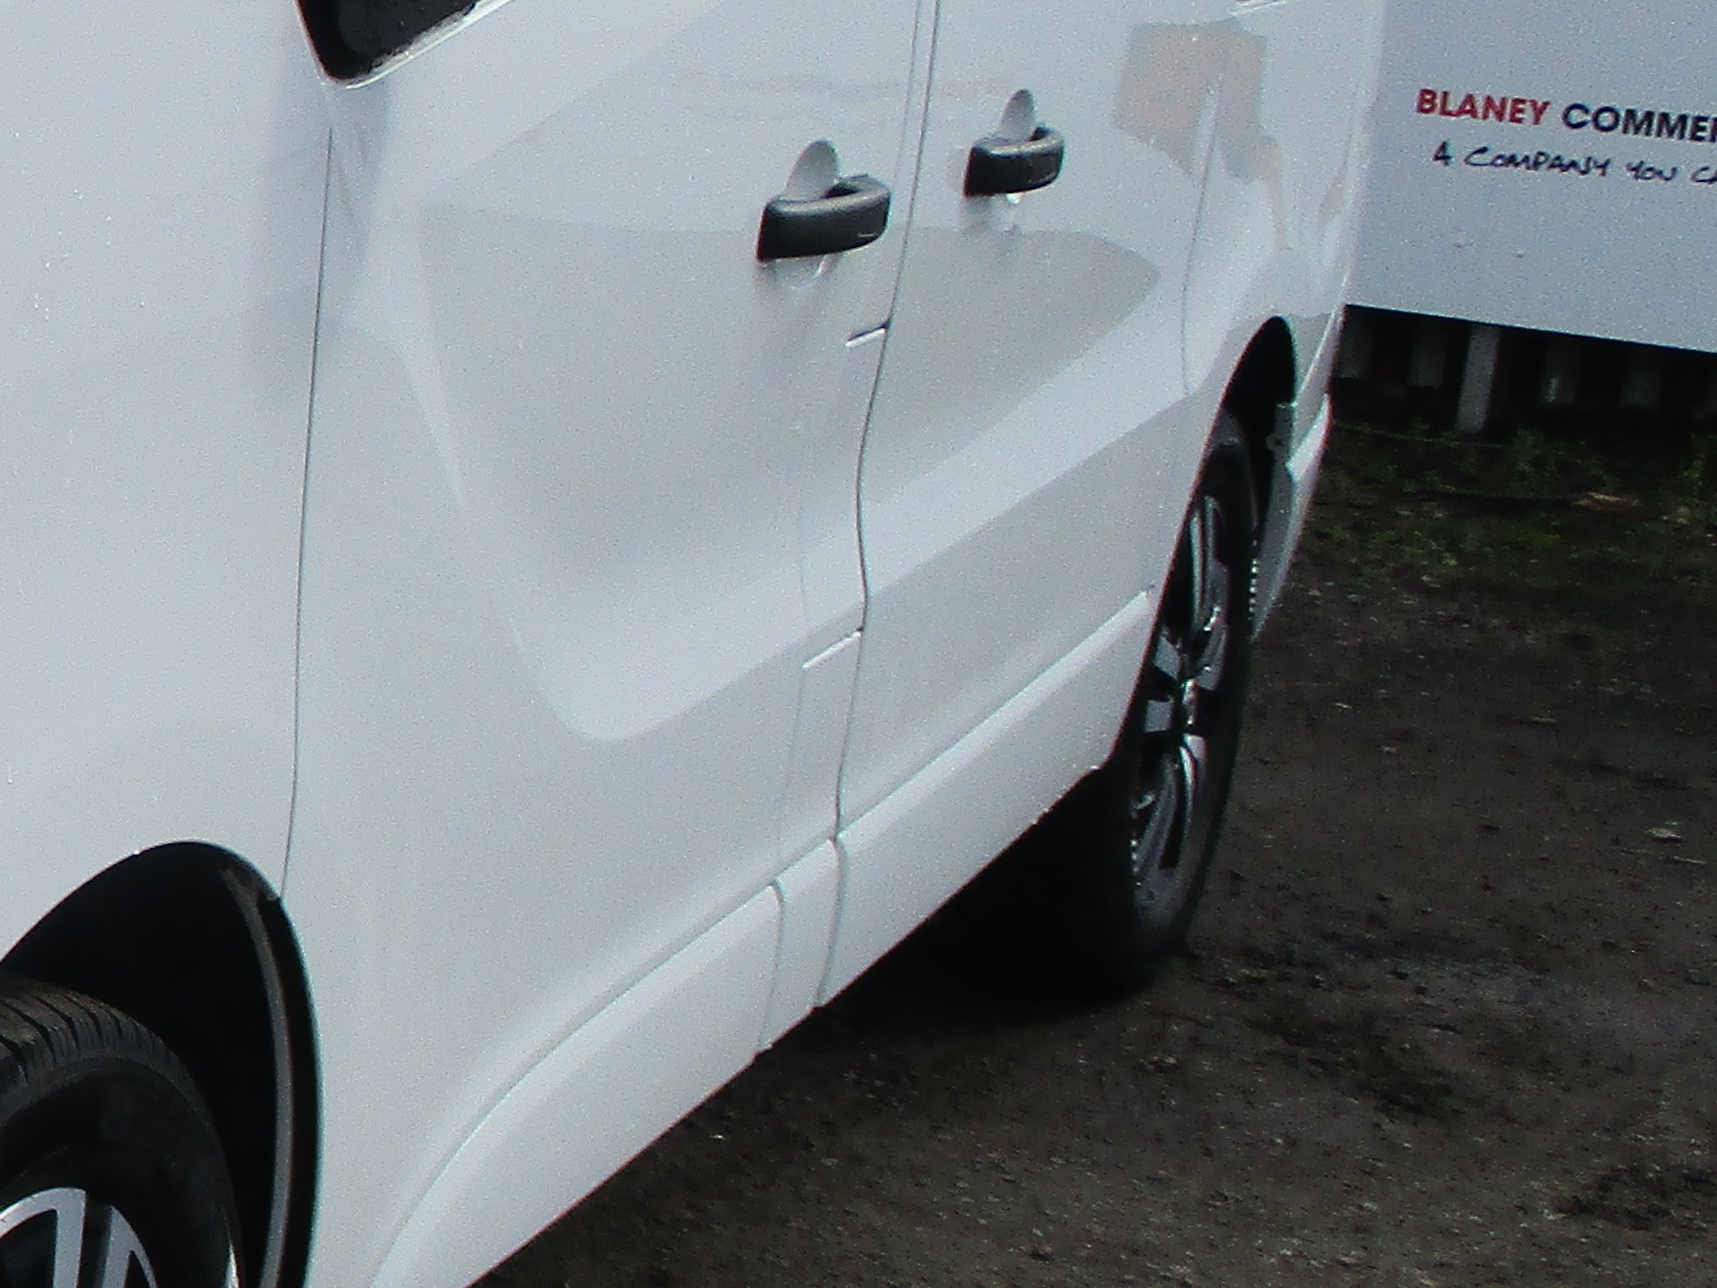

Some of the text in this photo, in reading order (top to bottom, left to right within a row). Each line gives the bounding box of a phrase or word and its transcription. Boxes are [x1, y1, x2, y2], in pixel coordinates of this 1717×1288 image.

[1415, 88, 1551, 126] BLANEY
[1465, 146, 1611, 177] COMPANY
[1626, 160, 1677, 182] YOU
